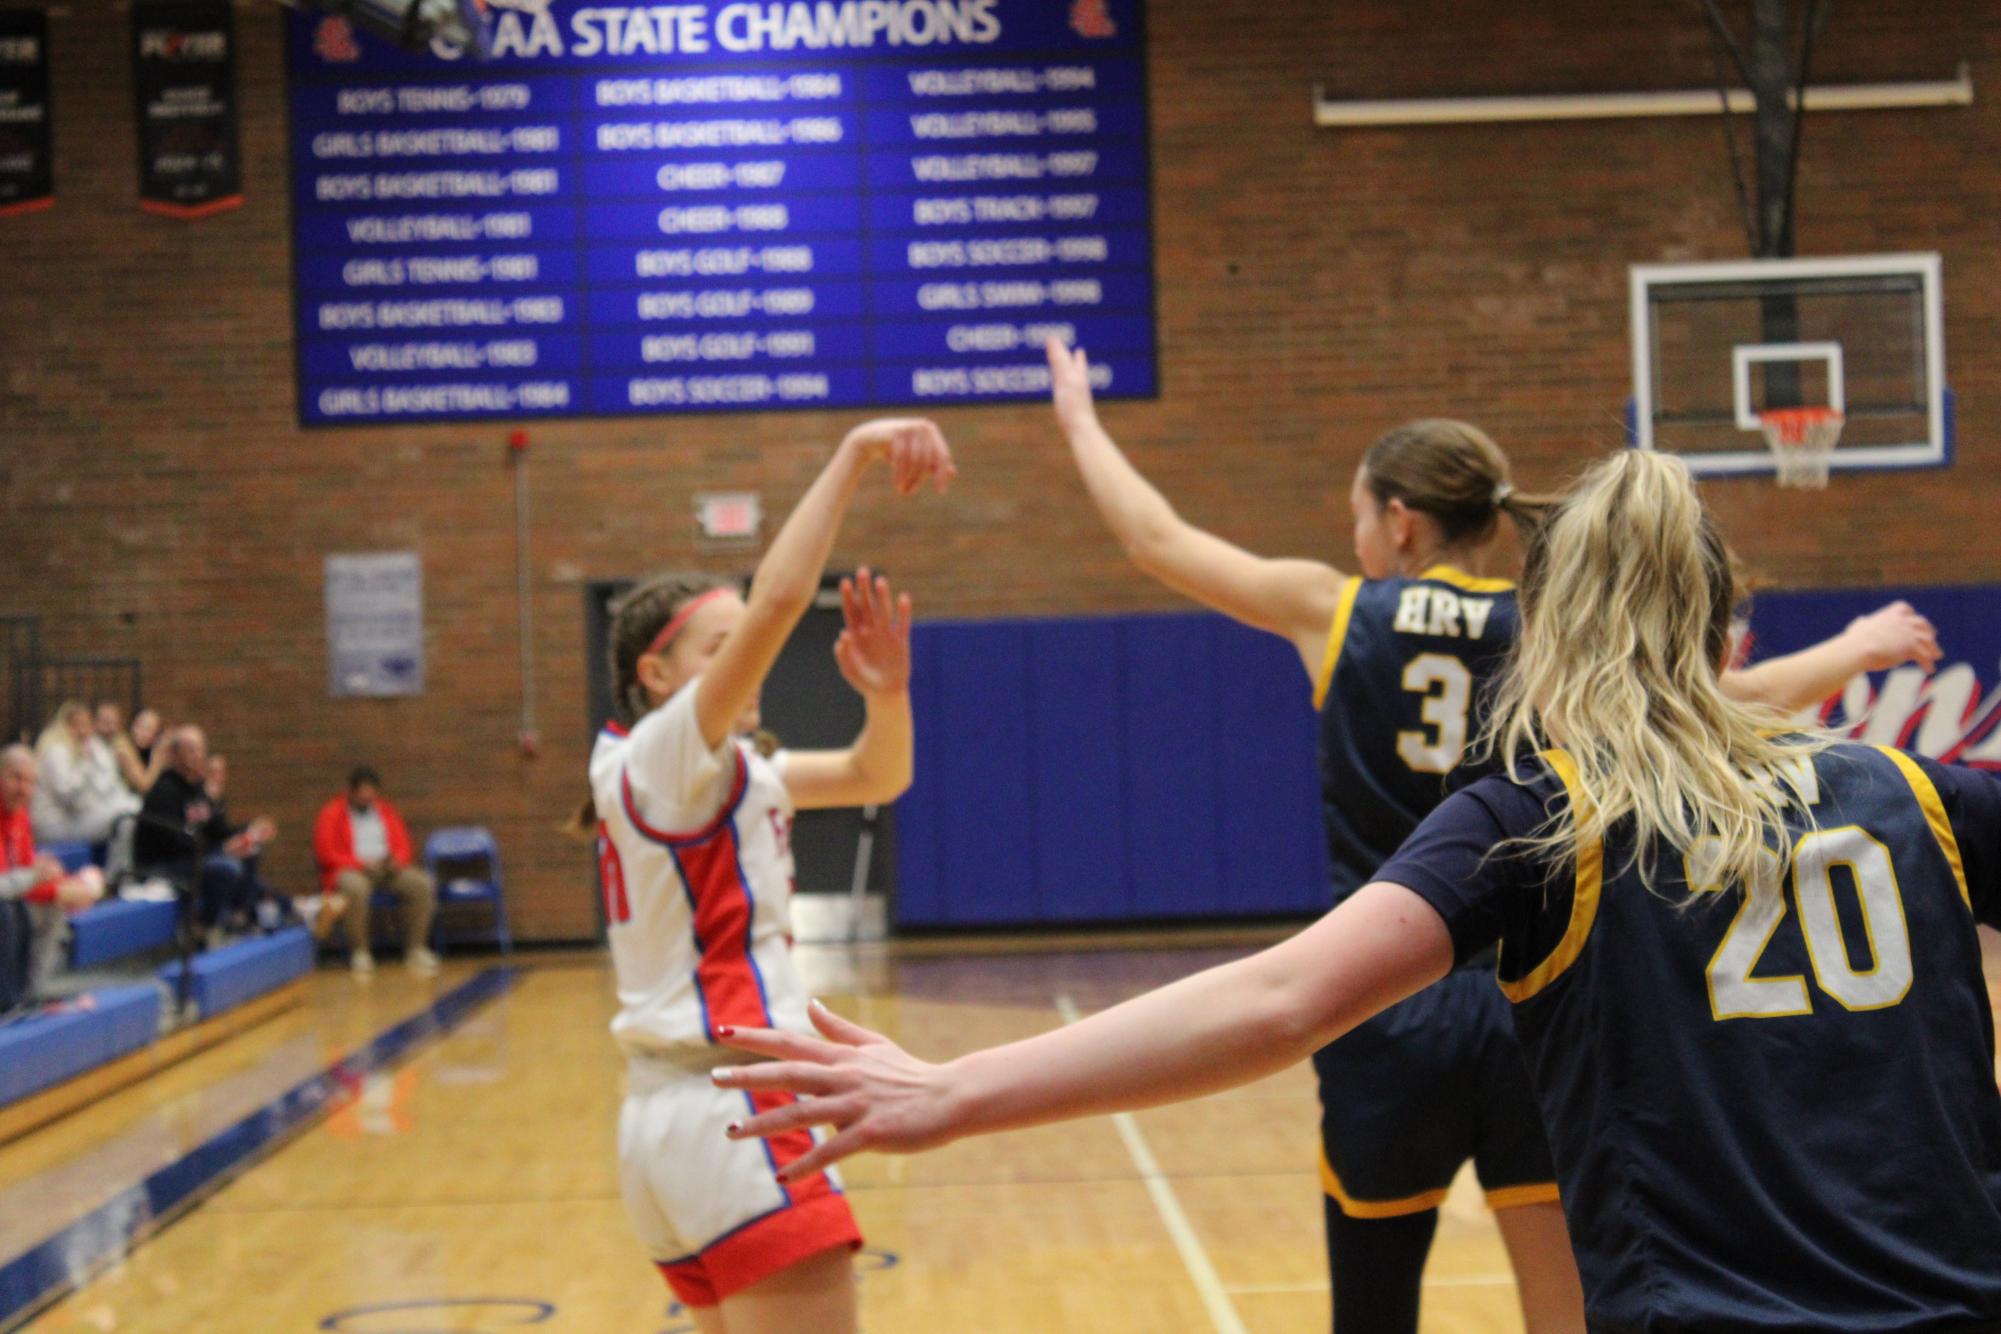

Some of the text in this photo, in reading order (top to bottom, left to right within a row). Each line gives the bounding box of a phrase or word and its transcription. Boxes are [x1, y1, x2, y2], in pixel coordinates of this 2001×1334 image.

[571, 4, 709, 57] STATE
[714, 0, 1001, 52] CHAMPIONS
[337, 88, 395, 114] BOYS
[595, 78, 654, 106] BOYS
[312, 132, 375, 158] GIRLS
[596, 122, 655, 151] BOYS
[316, 174, 374, 200] BOYS
[913, 198, 973, 225] BOYS
[635, 249, 694, 277] BOYS
[907, 241, 966, 268] BOYS
[342, 258, 406, 285] GIRLS
[637, 291, 696, 319] BOYS
[917, 283, 982, 310] GIRLS
[318, 302, 377, 329] BOYS
[641, 334, 700, 362] BOYS
[628, 377, 687, 406] BOYS
[912, 368, 970, 396] BOYS
[318, 388, 382, 415] GIRLS
[1393, 586, 1495, 640] HRV
[1397, 653, 1473, 775] 3
[1683, 824, 1914, 1021] 20
